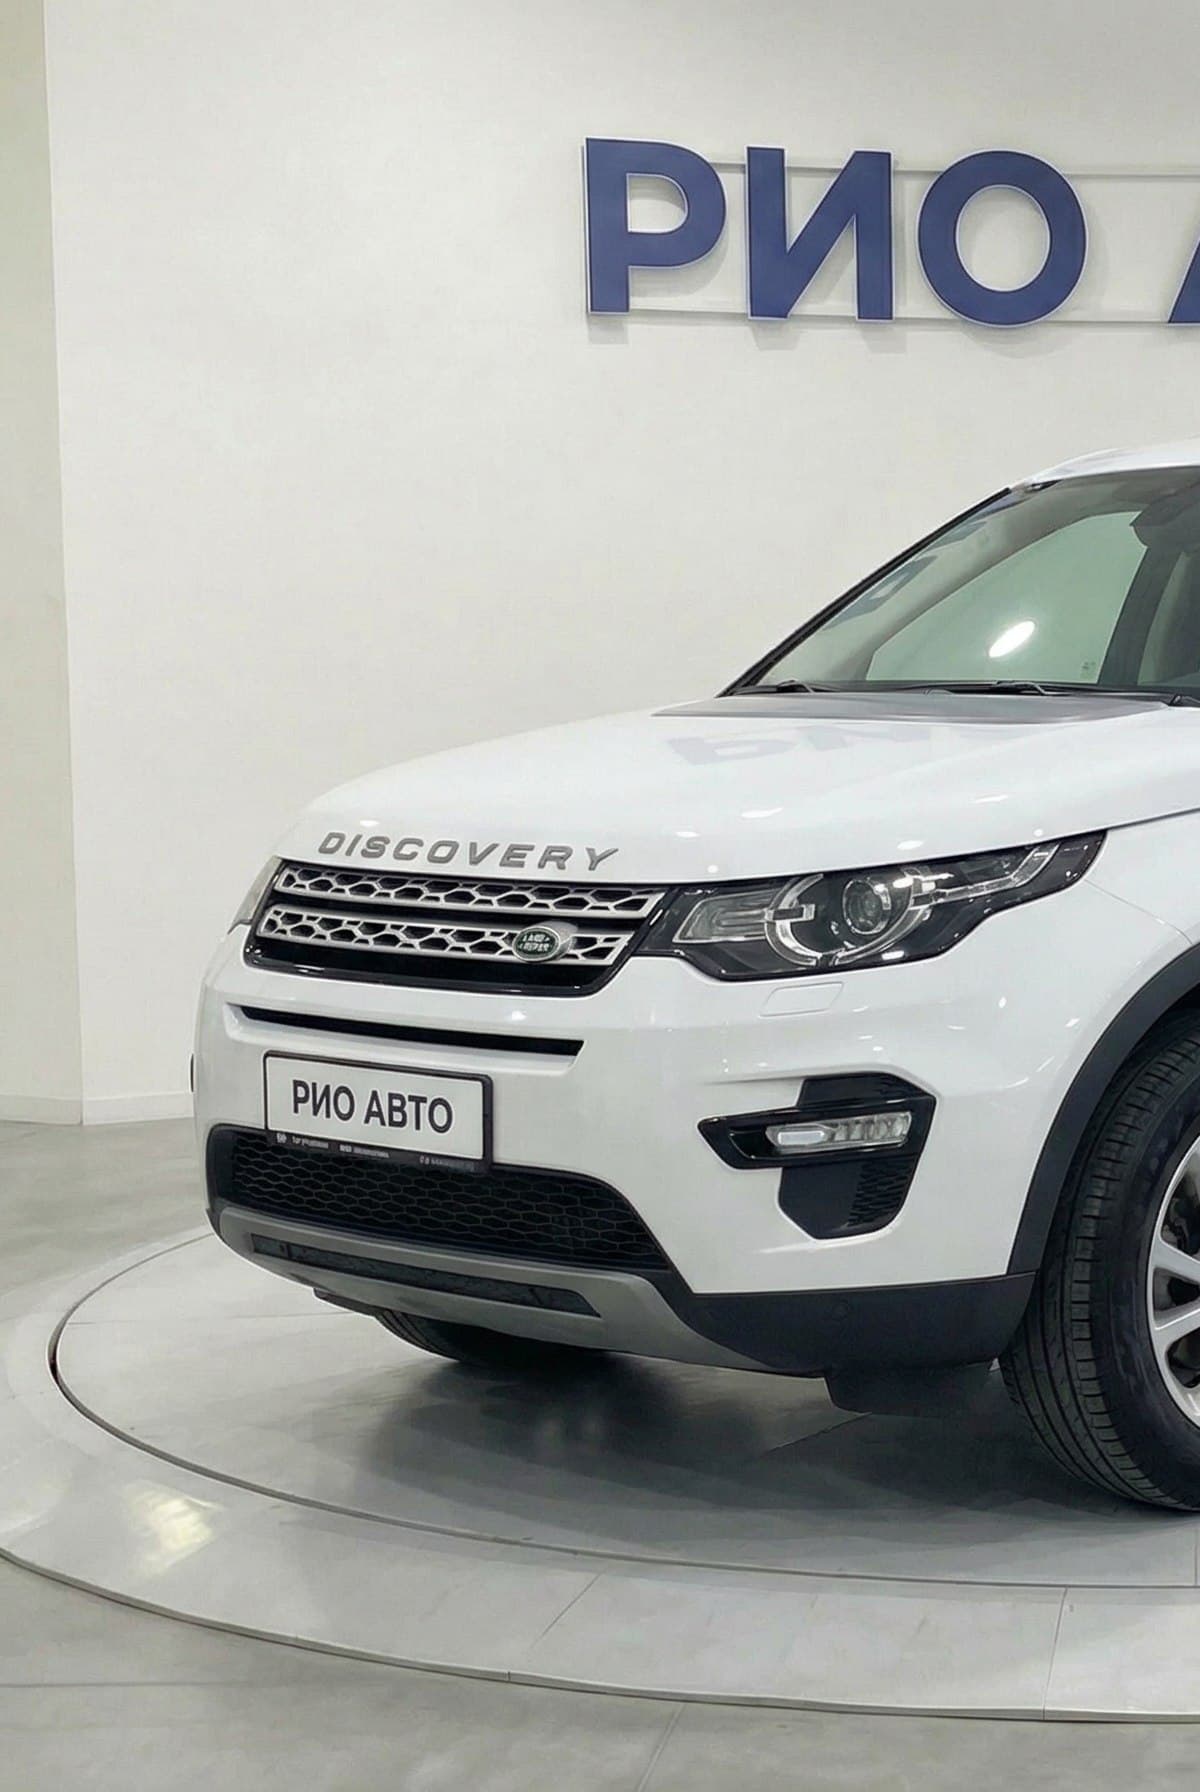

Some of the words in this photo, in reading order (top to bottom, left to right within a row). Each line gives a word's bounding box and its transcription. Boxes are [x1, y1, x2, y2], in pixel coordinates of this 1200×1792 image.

[584, 137, 1087, 328] РИО
[318, 831, 619, 871] DISCOVERY
[292, 1079, 355, 1121] РИО
[363, 1089, 454, 1134] АВТО
